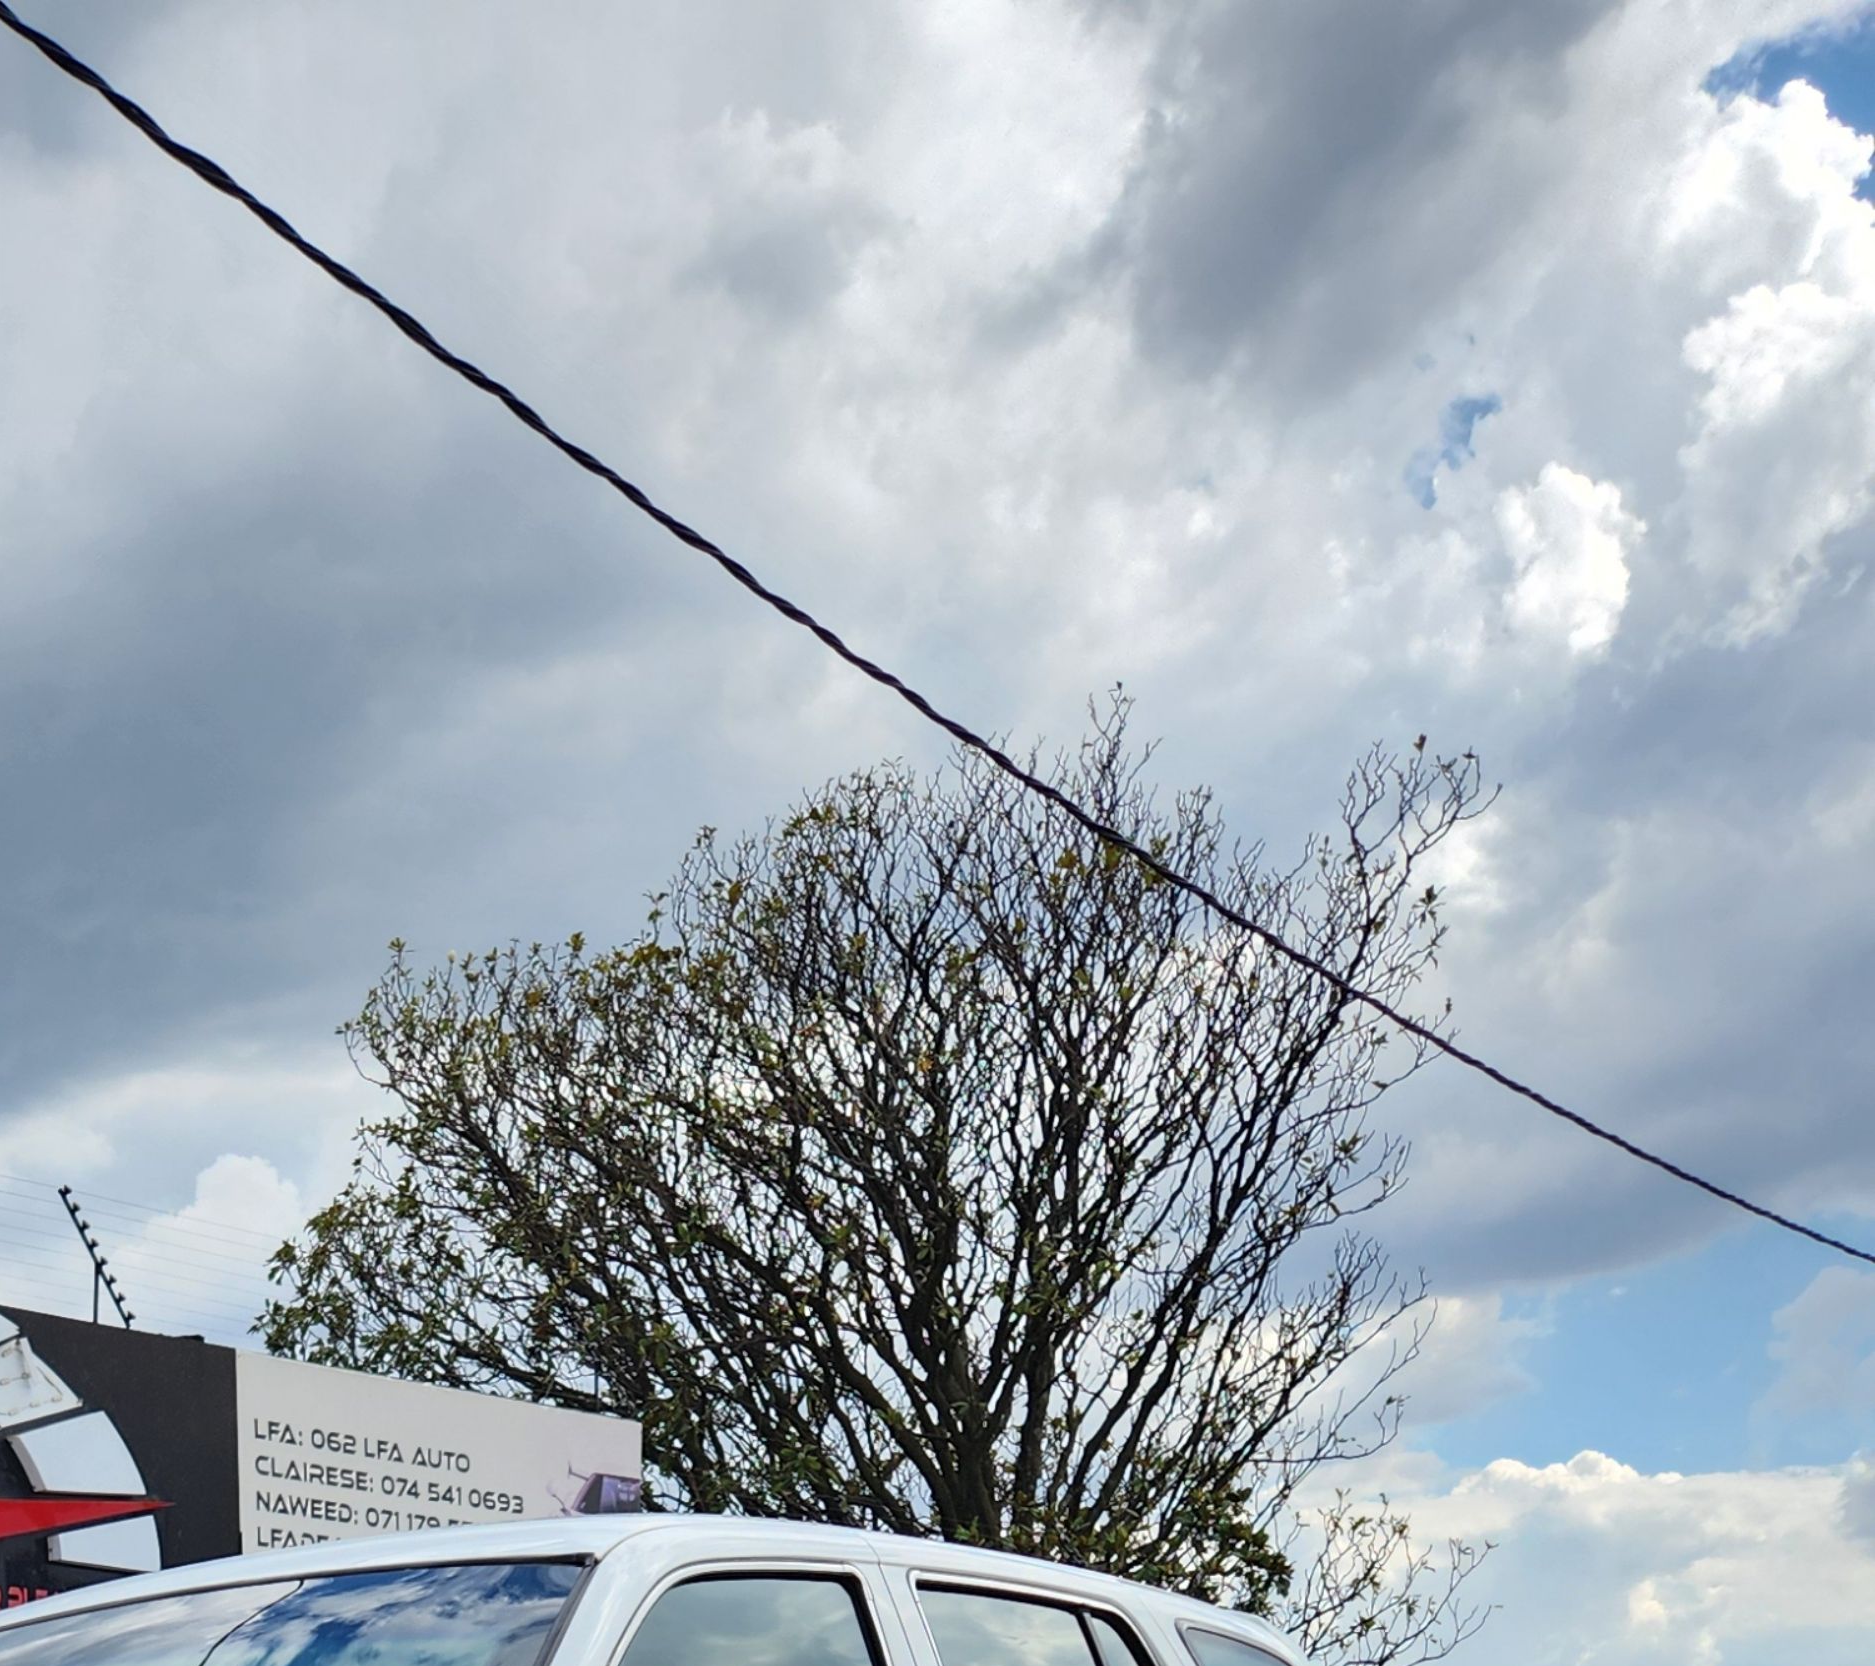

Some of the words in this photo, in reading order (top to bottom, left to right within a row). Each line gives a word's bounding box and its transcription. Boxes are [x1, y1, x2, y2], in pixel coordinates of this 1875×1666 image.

[253, 1417, 304, 1448] LFA:
[309, 1428, 357, 1455] 062
[362, 1436, 404, 1463] LFA
[411, 1446, 471, 1473] AUTO
[254, 1454, 375, 1493] CLAIRESE:
[380, 1475, 421, 1499] 074
[427, 1481, 463, 1506] 541
[467, 1488, 525, 1515] 0693
[255, 1490, 359, 1526] NAWEED:
[365, 1507, 400, 1531] 071
